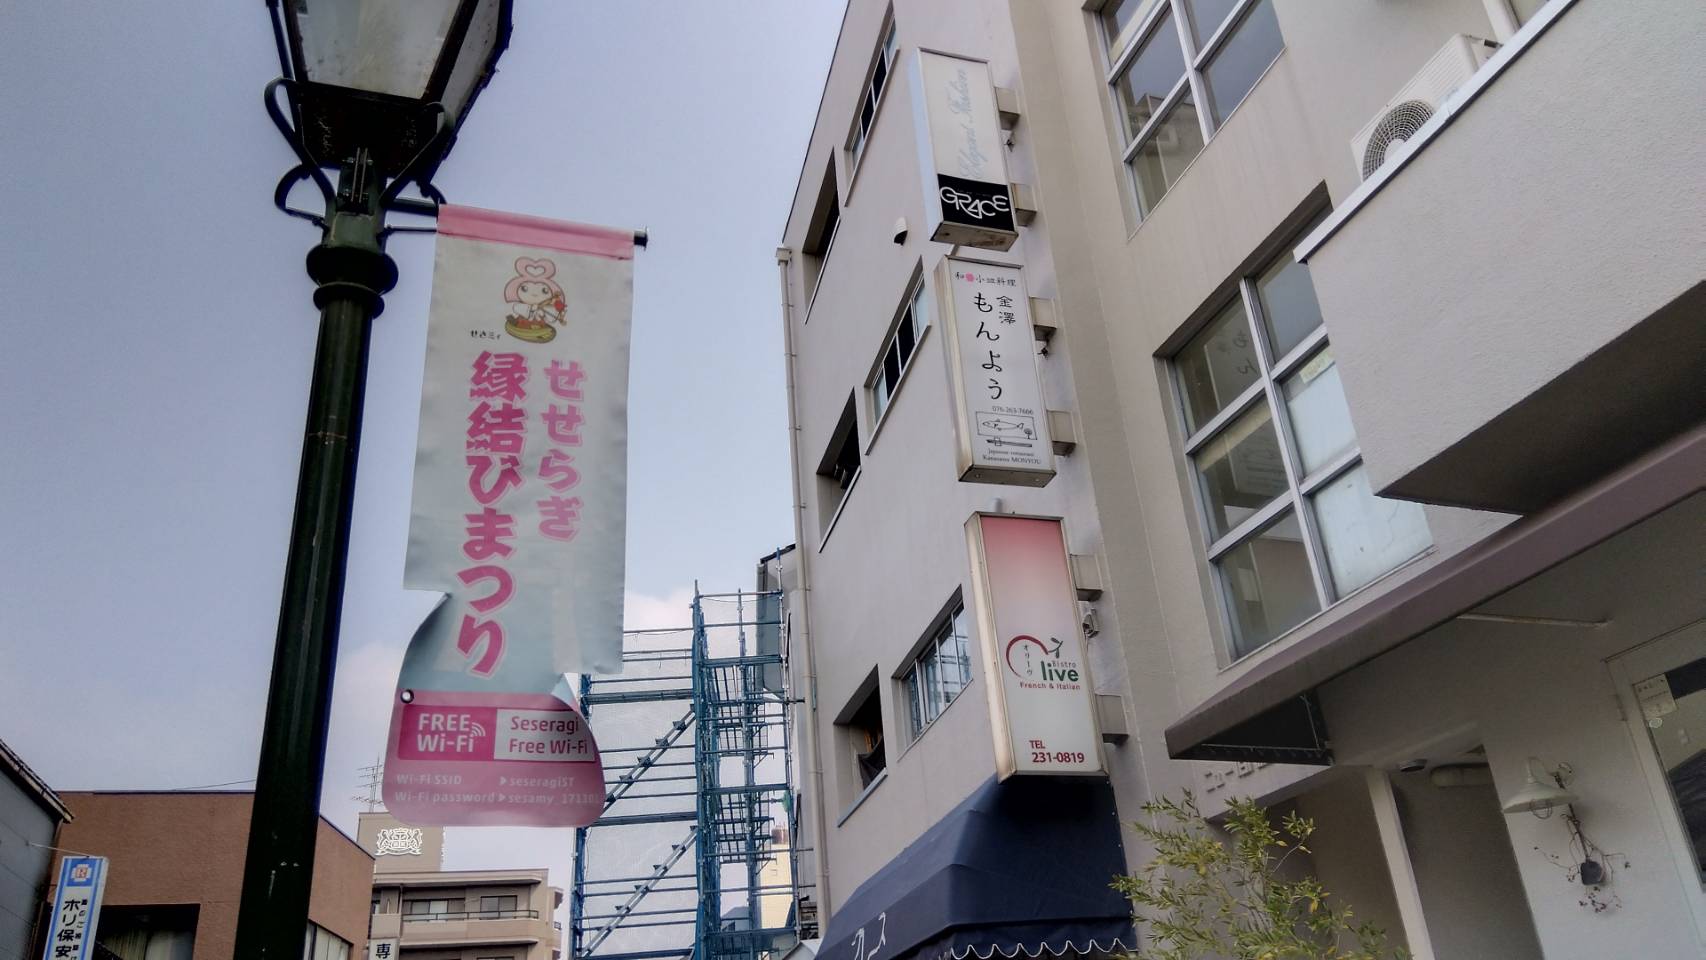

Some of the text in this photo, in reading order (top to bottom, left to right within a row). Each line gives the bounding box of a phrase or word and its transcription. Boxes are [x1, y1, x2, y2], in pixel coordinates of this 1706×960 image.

[940, 186, 1010, 219] GRACE
[996, 295, 1016, 324] 金澤
[974, 292, 1003, 400] もんよう
[536, 358, 587, 542] せせらぎ
[456, 350, 529, 678] 縁結びまつり
[418, 713, 471, 732] FREE
[510, 716, 579, 735] Seseragi
[417, 734, 474, 753] Wi-Fi
[509, 738, 588, 755] Free Wi-Fi
[1029, 740, 1046, 749] TEL
[1031, 752, 1085, 763] 231-0819
[434, 774, 463, 785] SSID
[432, 791, 496, 804] password
[55, 899, 82, 958] ホリ保安
[376, 943, 392, 960] 専
